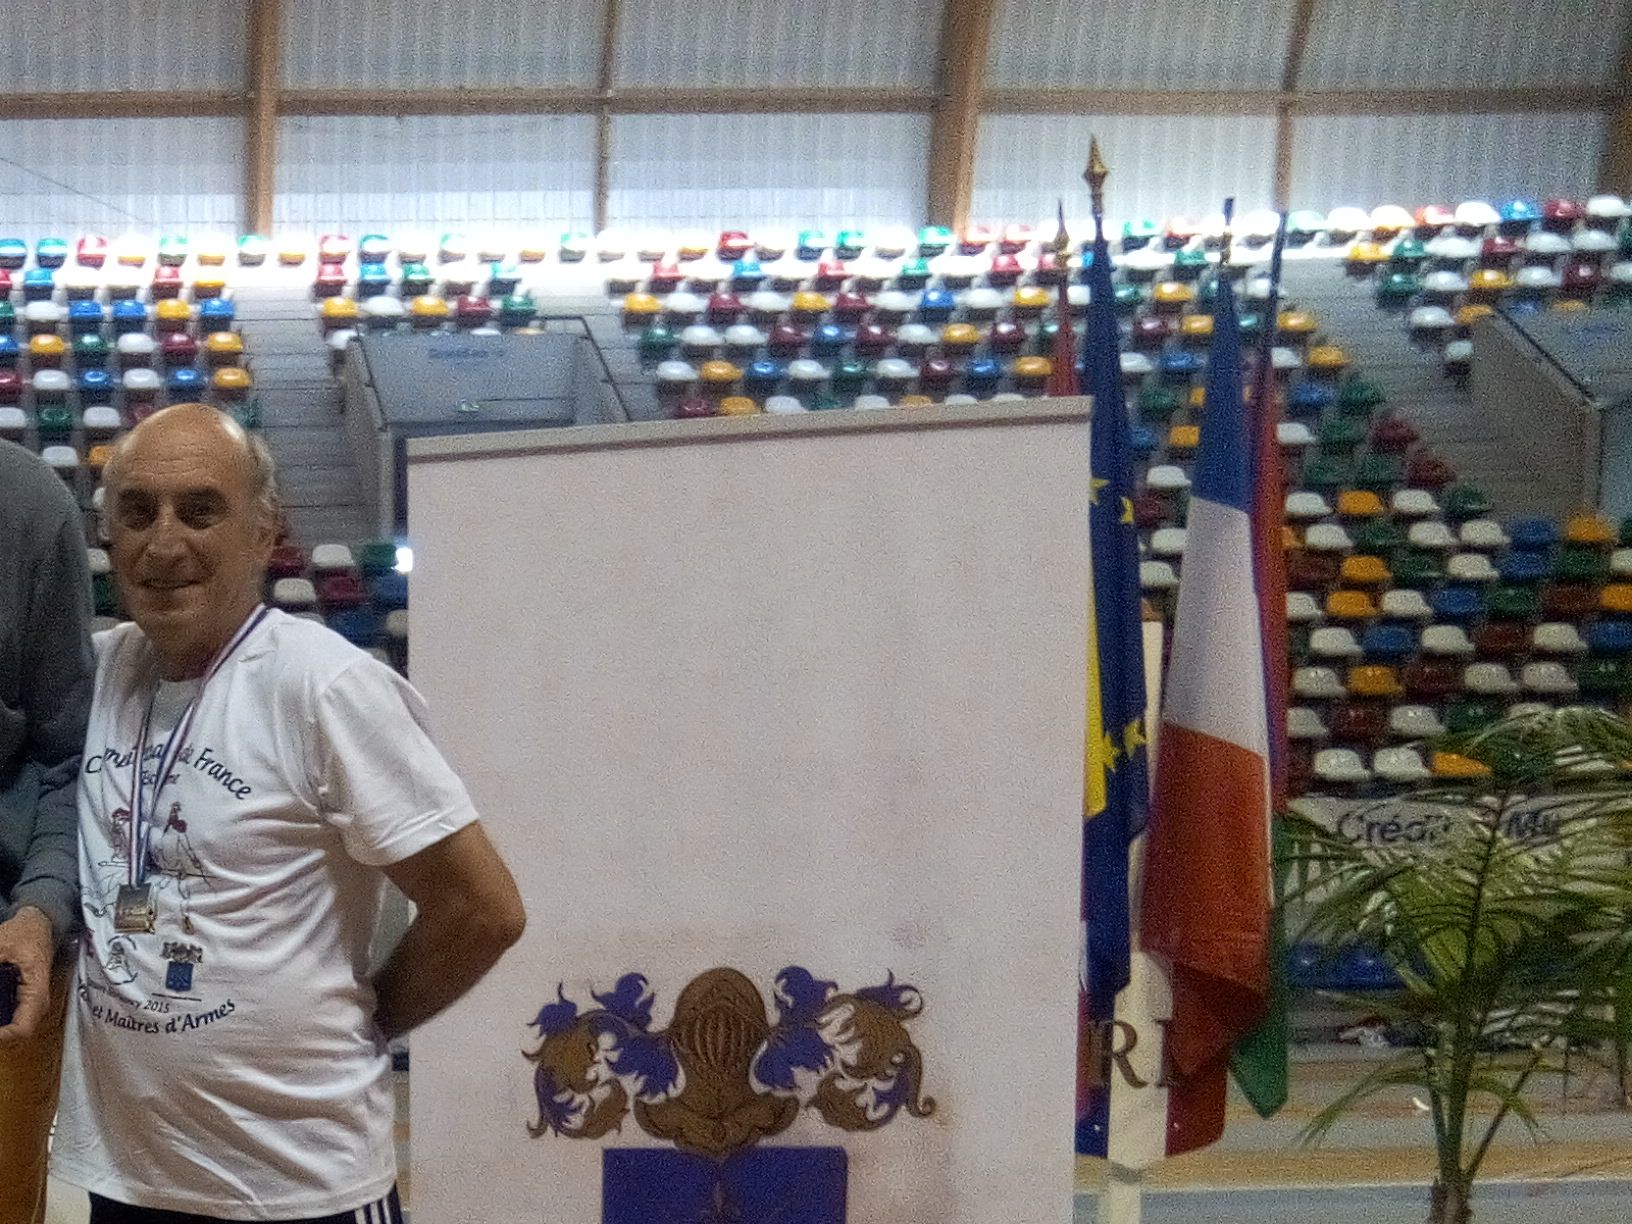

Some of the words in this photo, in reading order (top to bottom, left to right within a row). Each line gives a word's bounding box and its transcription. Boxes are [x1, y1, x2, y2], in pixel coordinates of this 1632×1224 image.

[194, 747, 251, 800] France
[104, 1008, 160, 1034] Maîtres
[165, 998, 236, 1034] d'Armes
[144, 1000, 170, 1014] 2015
